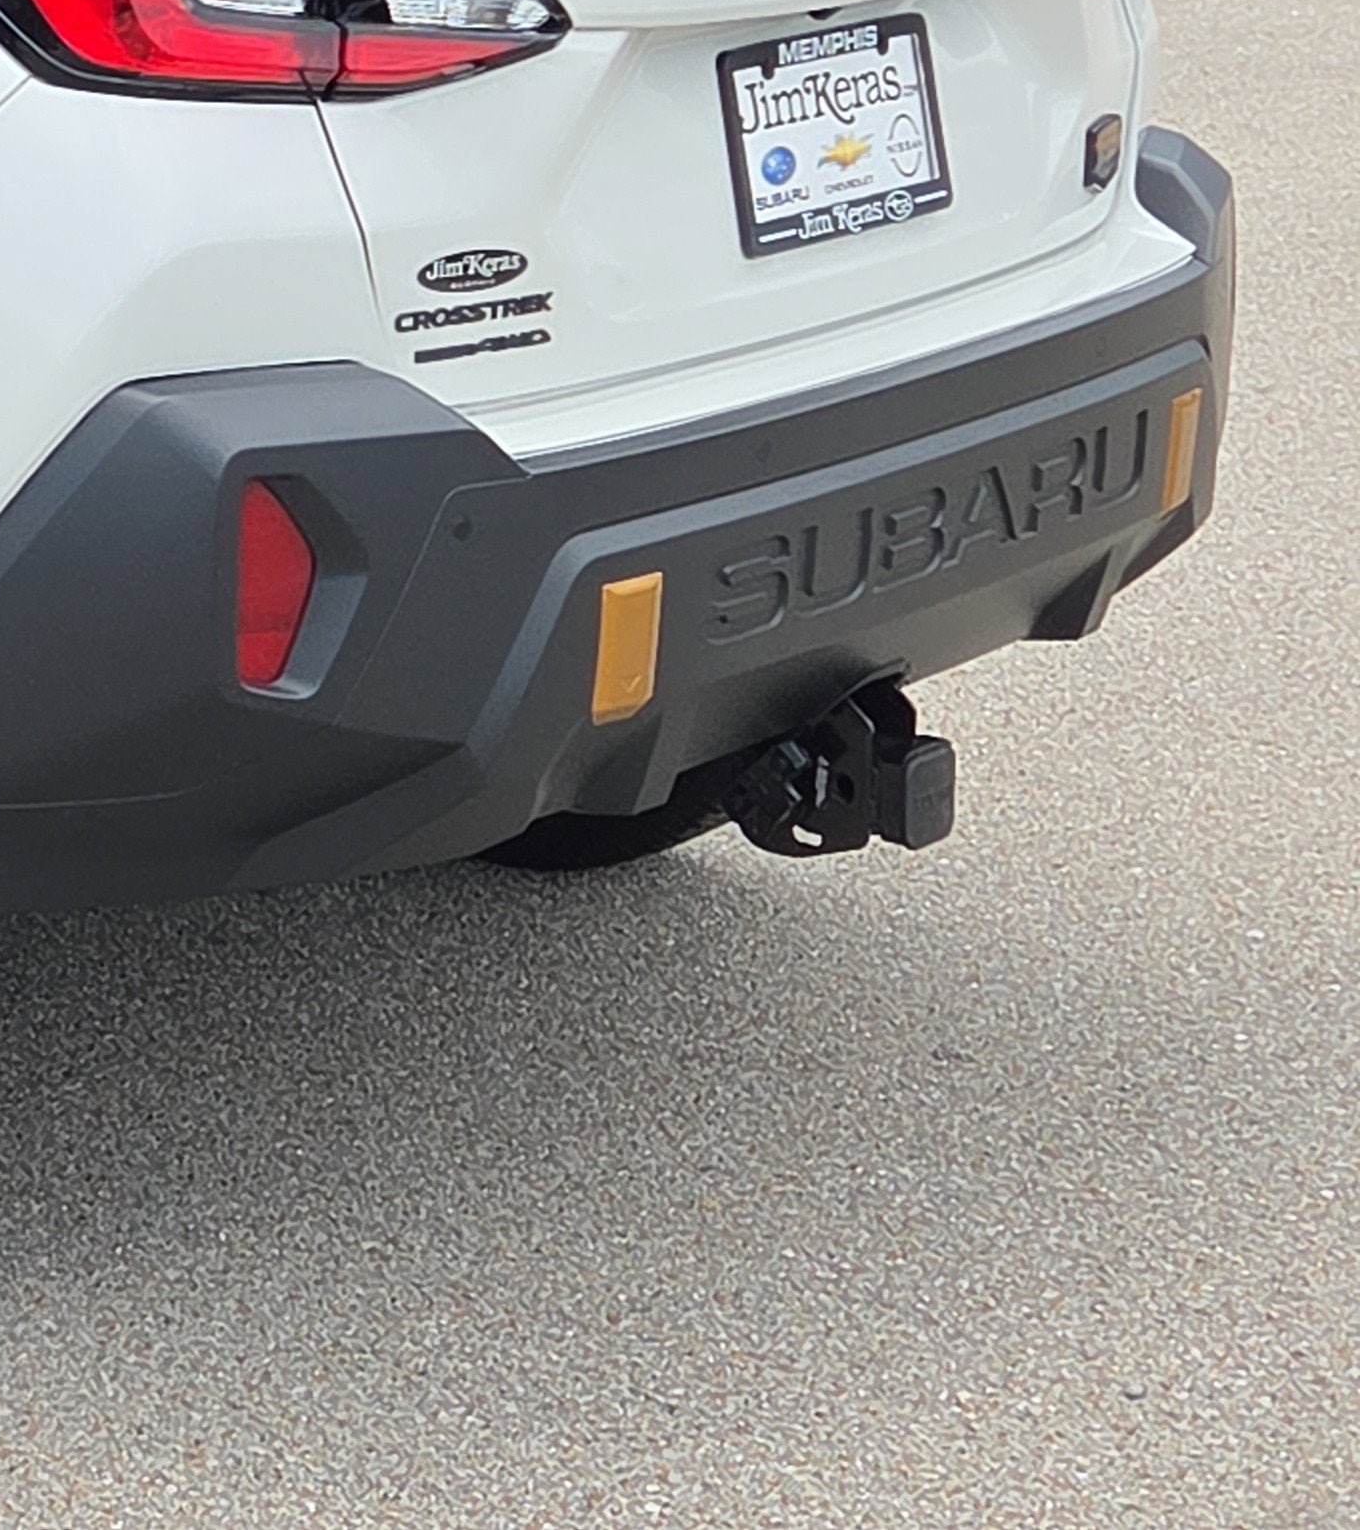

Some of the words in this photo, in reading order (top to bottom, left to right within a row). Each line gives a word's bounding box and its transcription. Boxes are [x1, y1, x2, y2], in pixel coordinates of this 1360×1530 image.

[779, 26, 877, 64] MEMPHIS
[756, 186, 811, 211] SUBARU
[394, 291, 554, 333] CROSSTREK
[706, 408, 1149, 647] SUBARU
